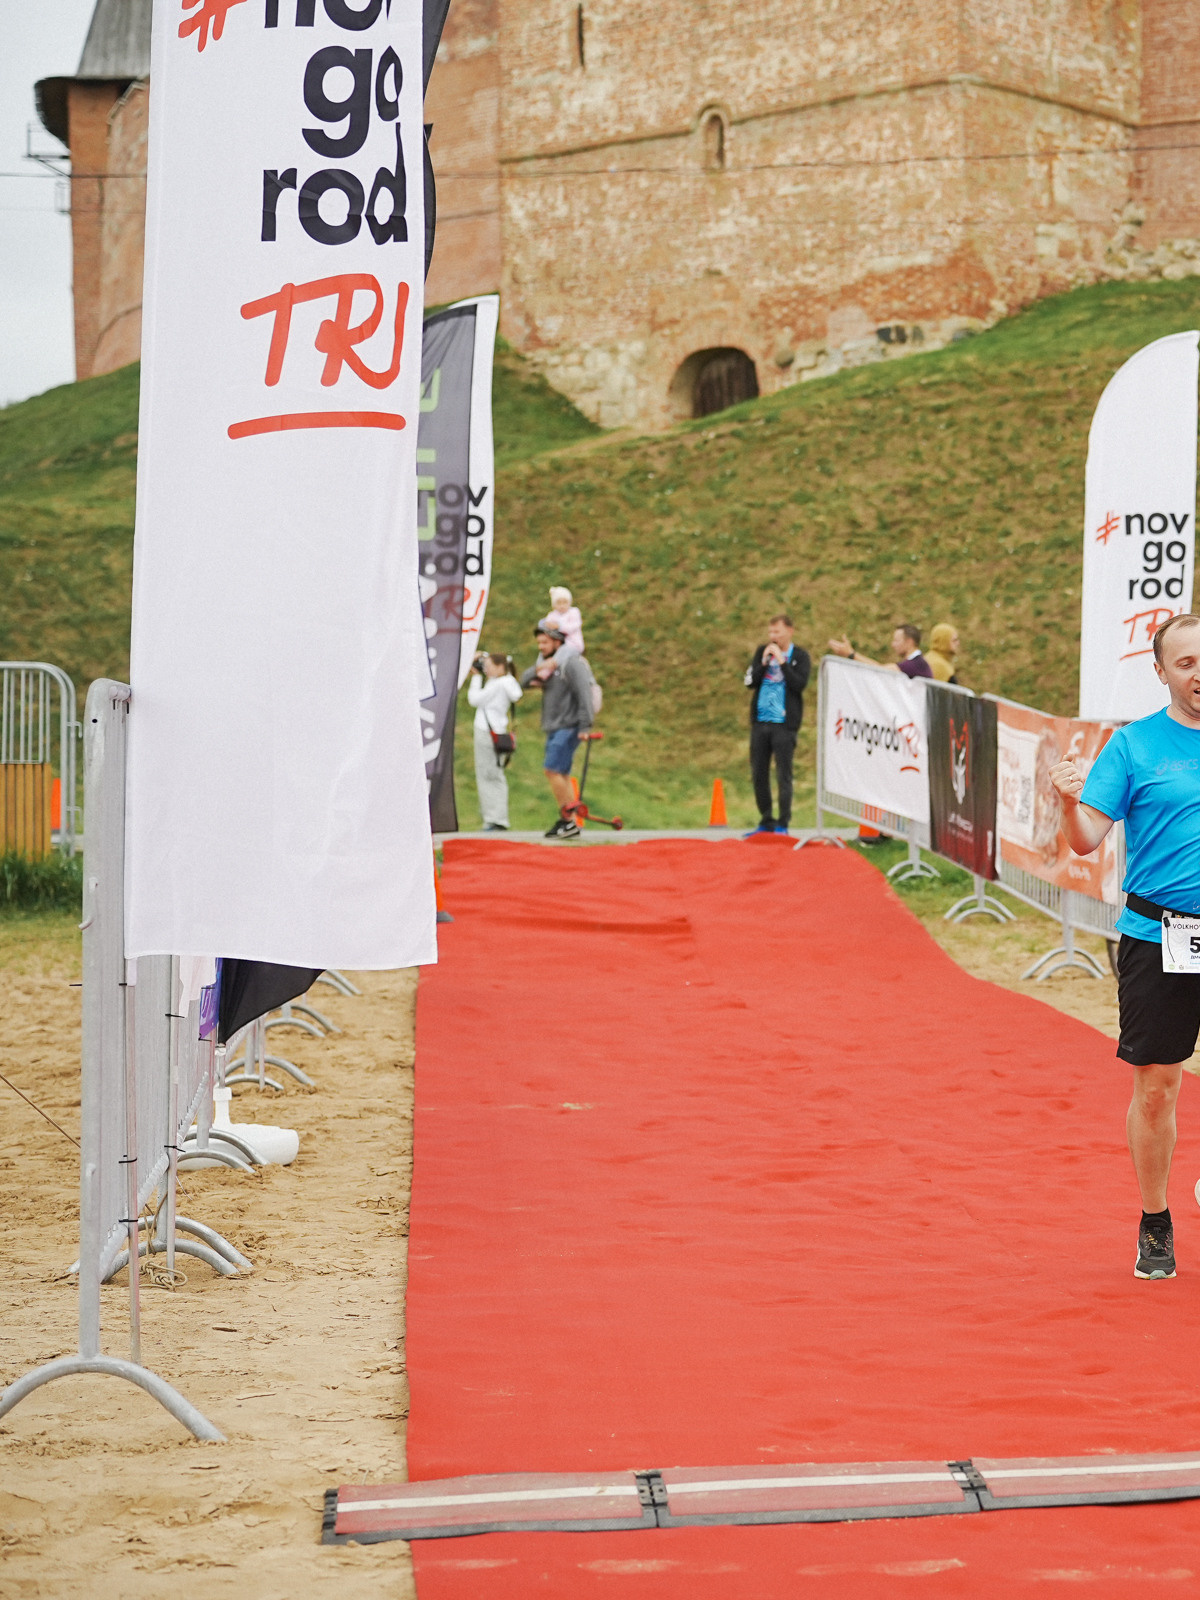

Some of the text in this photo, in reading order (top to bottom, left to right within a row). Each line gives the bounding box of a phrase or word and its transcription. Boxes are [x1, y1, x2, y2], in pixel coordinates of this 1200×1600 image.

[302, 46, 403, 159] go
[261, 122, 409, 245] rod
[1129, 564, 1184, 600] rod
[1143, 540, 1186, 573] go
